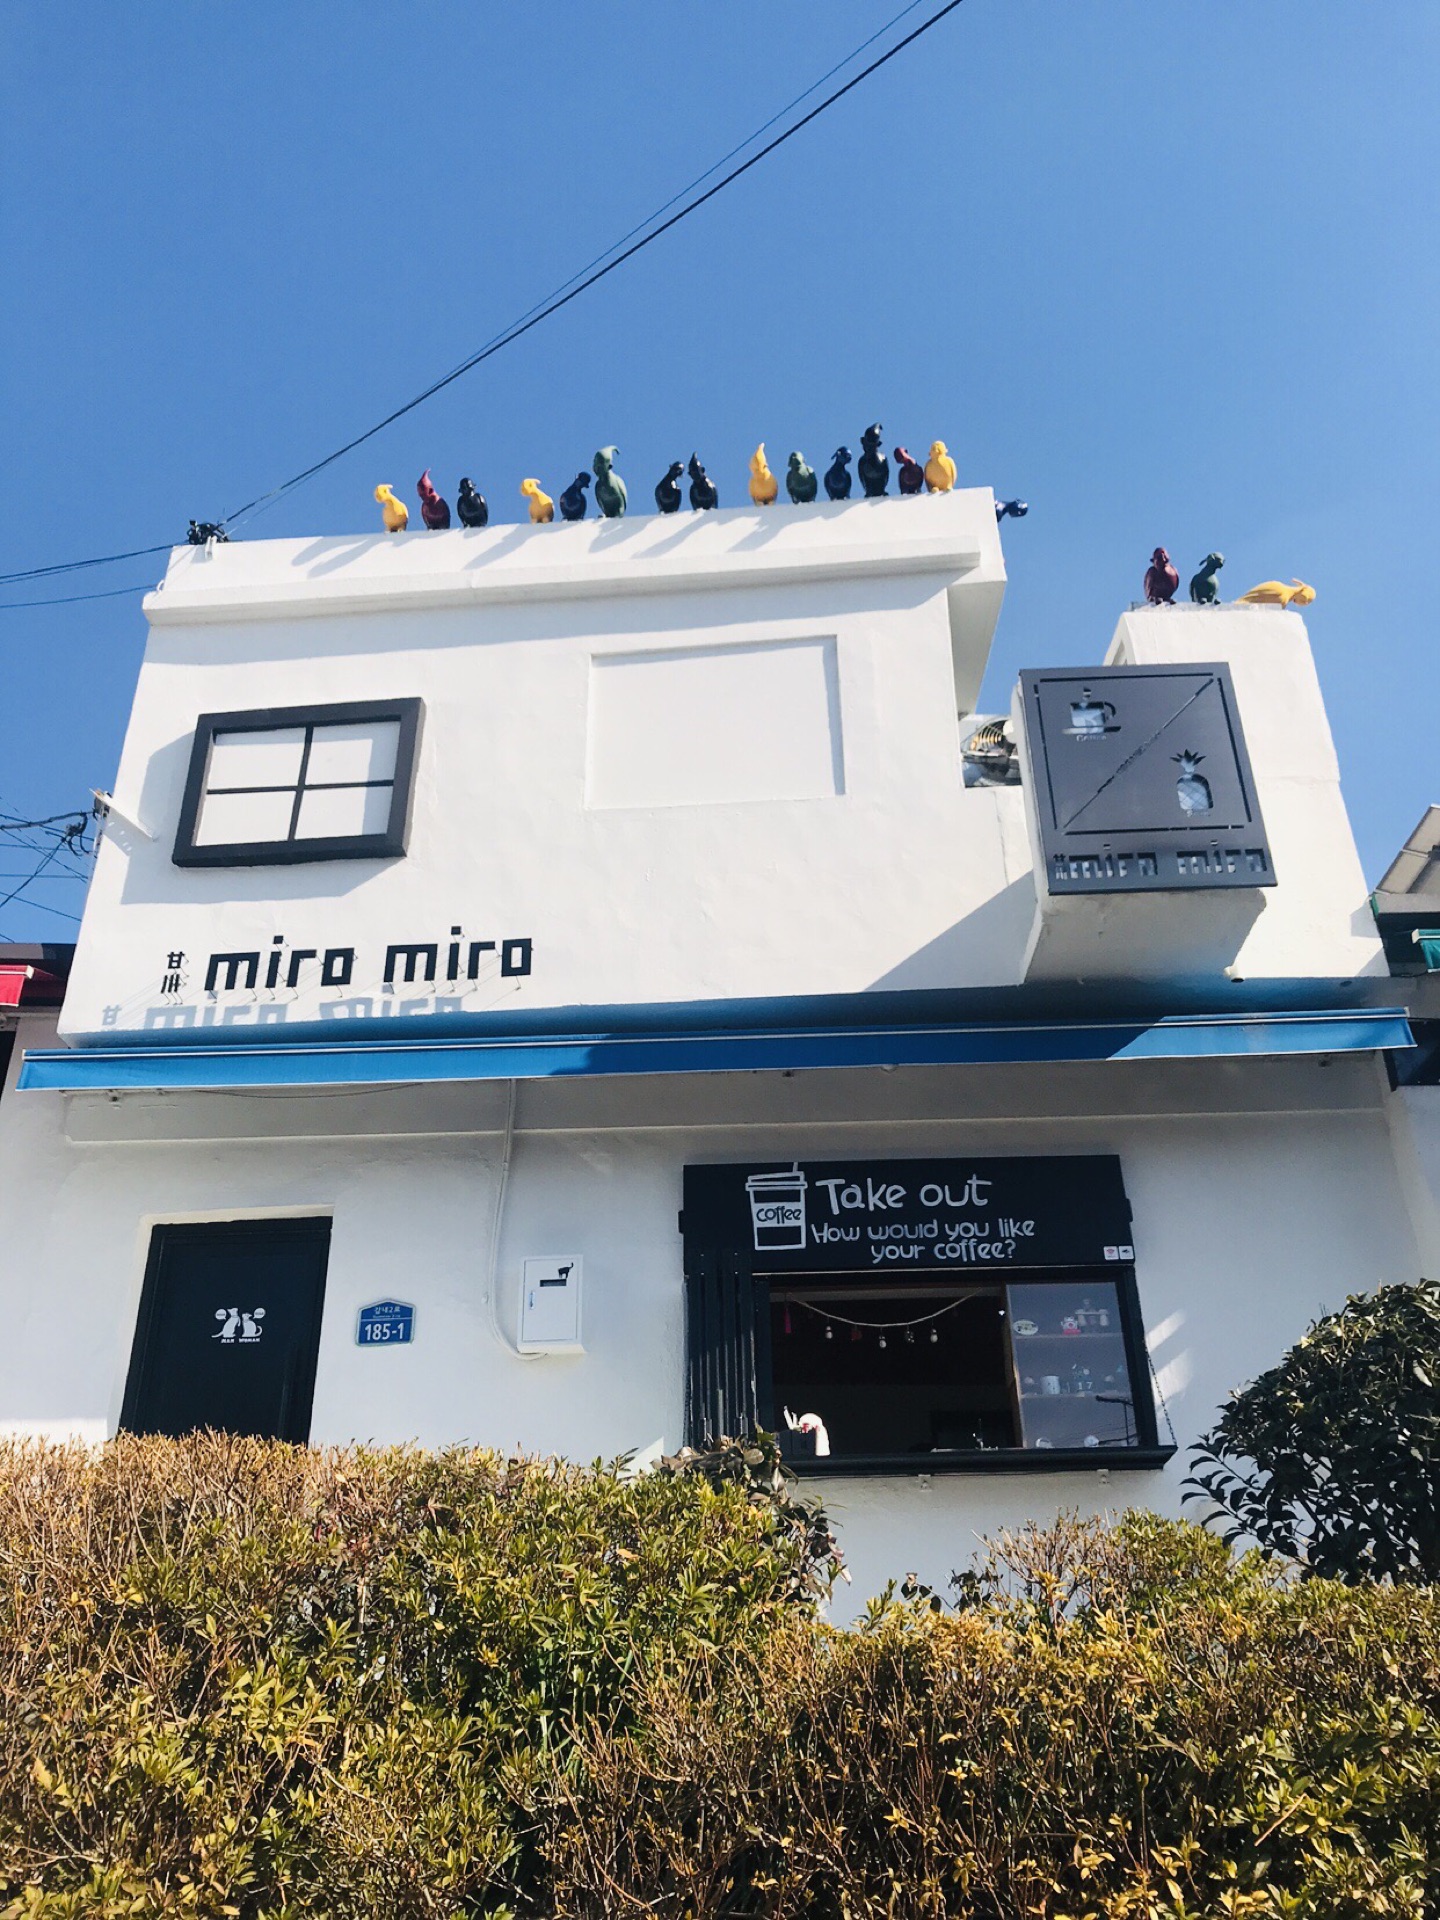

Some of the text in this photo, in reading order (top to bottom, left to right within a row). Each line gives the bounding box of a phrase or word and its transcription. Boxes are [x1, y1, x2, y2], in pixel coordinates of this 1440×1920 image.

[204, 926, 533, 991] miro miro
[815, 1174, 993, 1215] Take out
[756, 1207, 802, 1225] coffee
[811, 1218, 1036, 1243] How would you like
[871, 1239, 1016, 1264] your coffee?
[364, 1322, 405, 1341] 185-1
